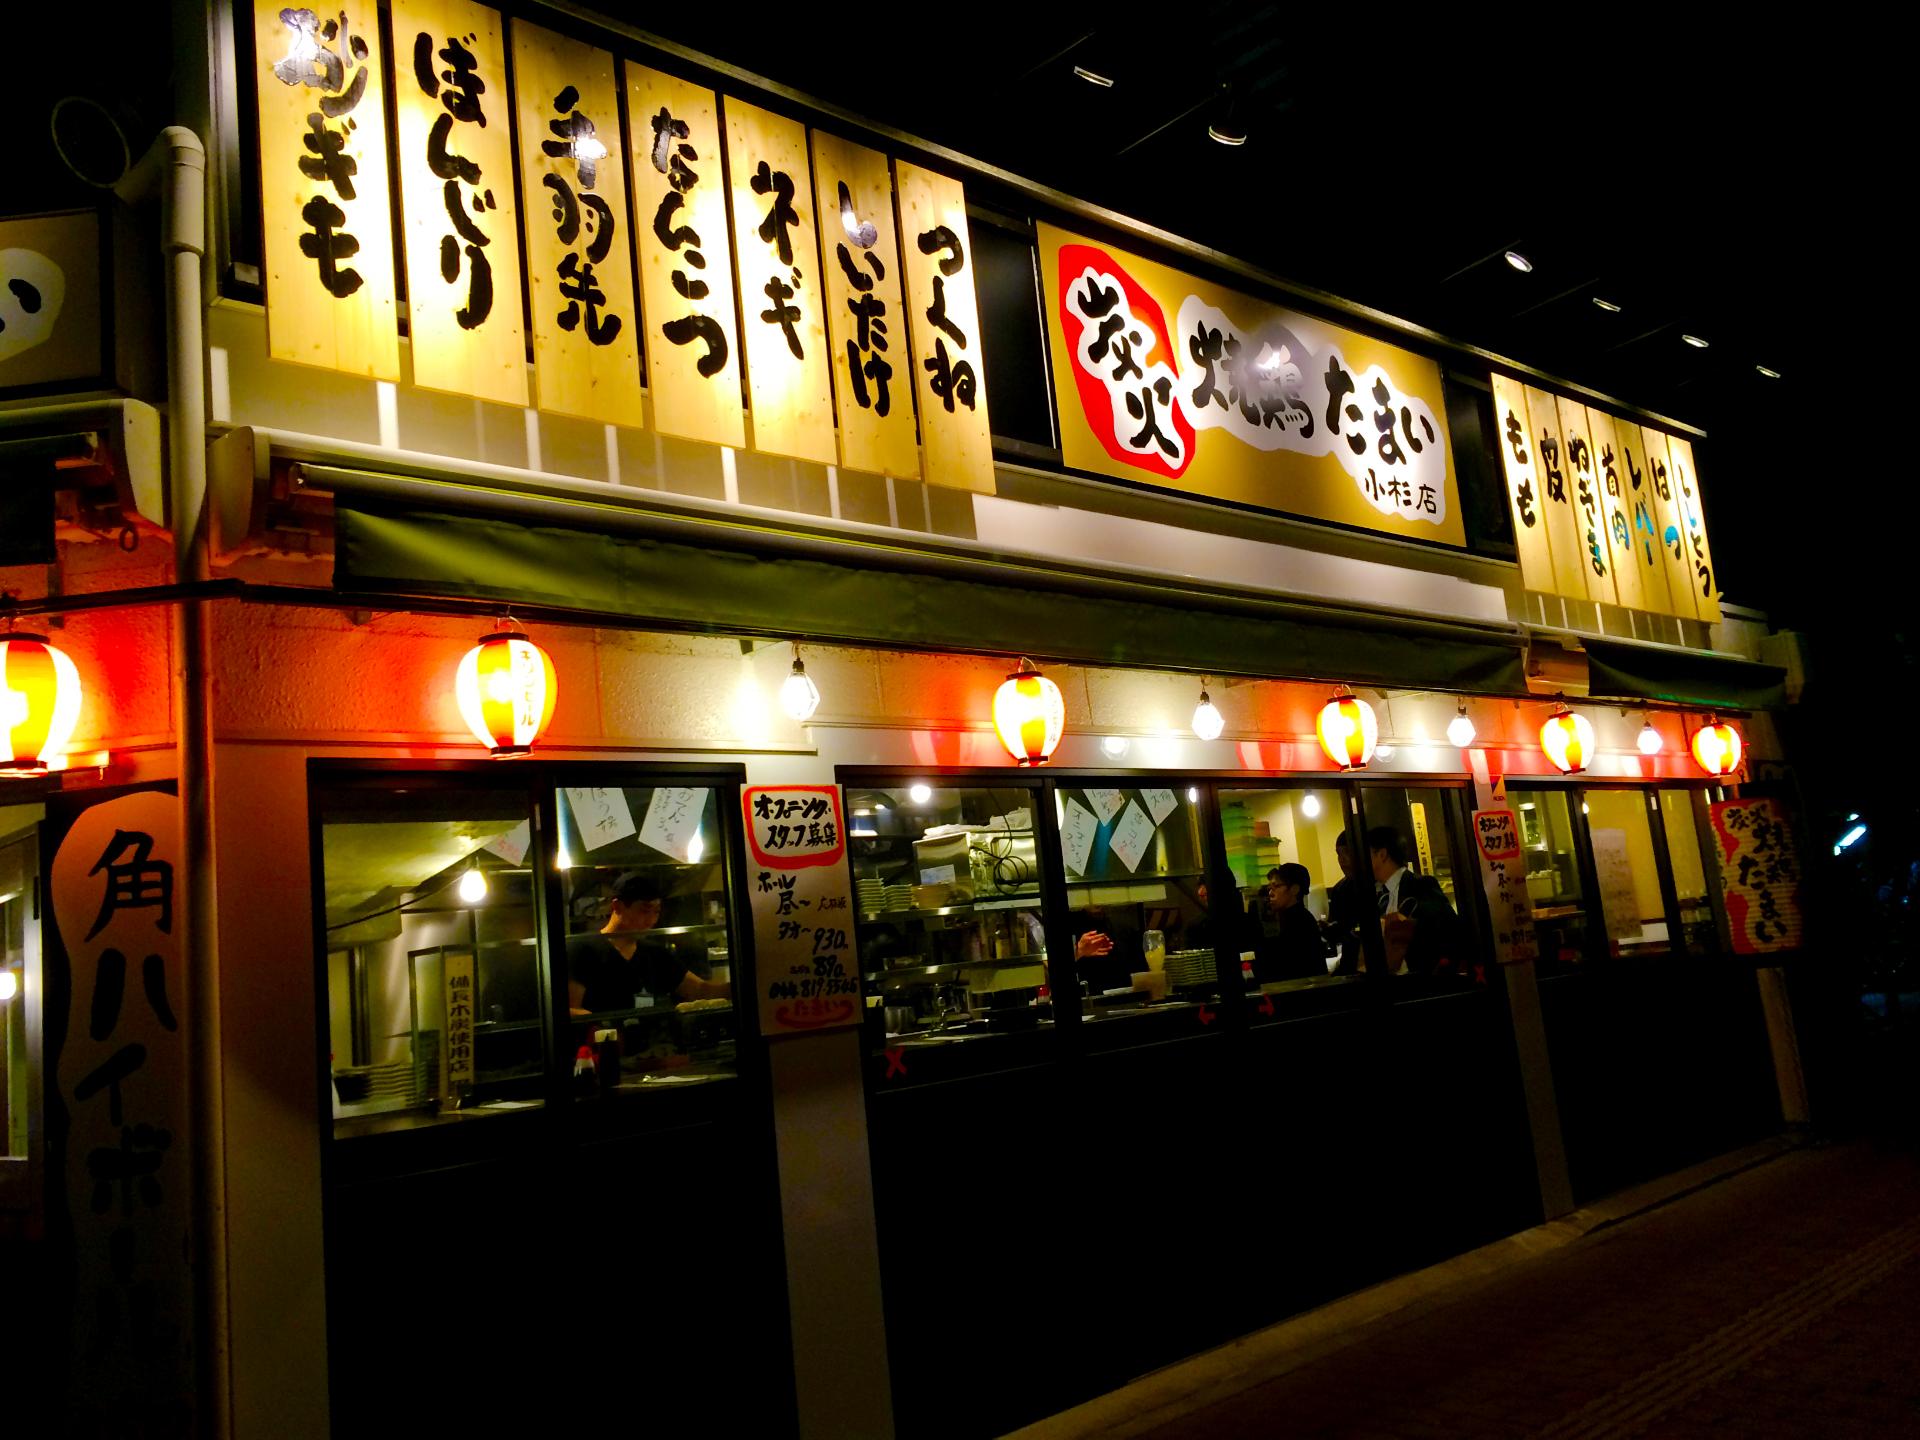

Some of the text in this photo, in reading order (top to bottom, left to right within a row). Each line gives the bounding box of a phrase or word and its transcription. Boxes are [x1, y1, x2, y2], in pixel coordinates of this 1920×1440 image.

[413, 31, 497, 330] ぼんじり
[541, 85, 622, 346] 手羽先
[651, 106, 728, 378] なんこつ
[750, 160, 804, 361] ネギ
[837, 181, 892, 418] しいたけ
[917, 224, 977, 413] つくね
[1078, 276, 1180, 459] 炭火
[1324, 355, 1436, 466] たまい
[1363, 467, 1438, 515] 小杉店
[1505, 409, 1536, 529] もも
[1677, 463, 1711, 598] ししとう
[753, 793, 832, 820] オープニング
[757, 871, 797, 893] ホール
